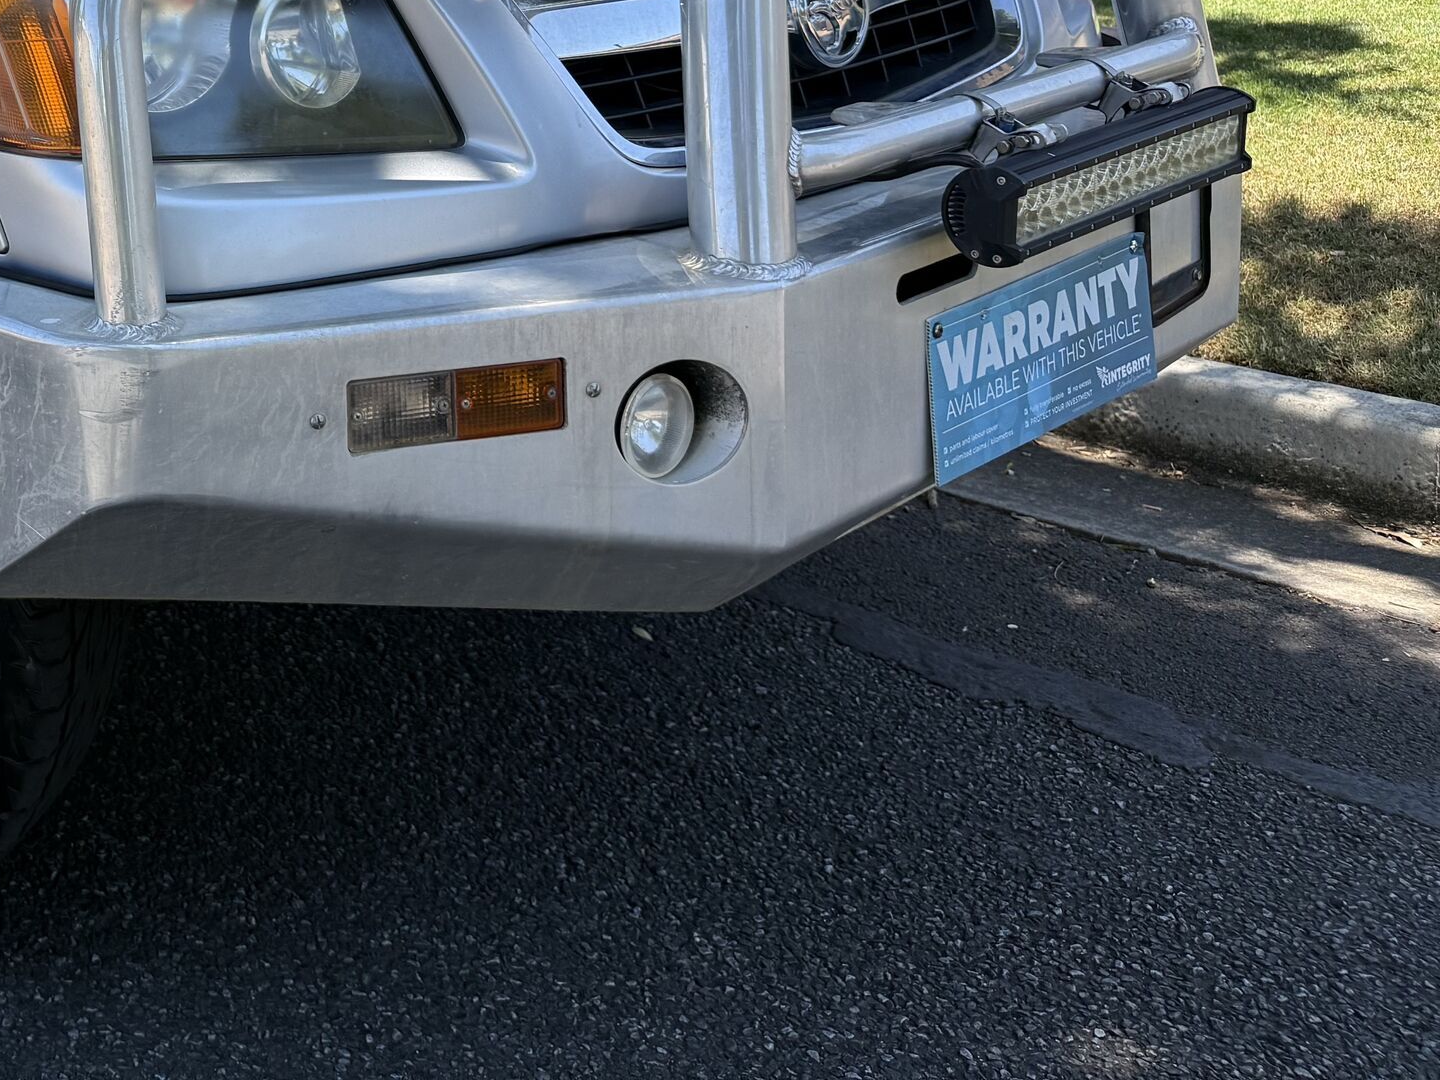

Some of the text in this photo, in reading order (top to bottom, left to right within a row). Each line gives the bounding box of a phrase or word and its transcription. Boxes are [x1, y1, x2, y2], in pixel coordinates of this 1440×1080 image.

[936, 257, 1139, 391] WARRANTY
[946, 368, 1021, 421] AVAILABLE
[1022, 352, 1056, 383] WITH
[1058, 338, 1086, 368] THIS
[1108, 353, 1151, 384] INTEGRITY
[1030, 409, 1052, 426] PROTECT
[1051, 403, 1065, 416] YOUR
[1065, 389, 1093, 410] INVESTMENT
